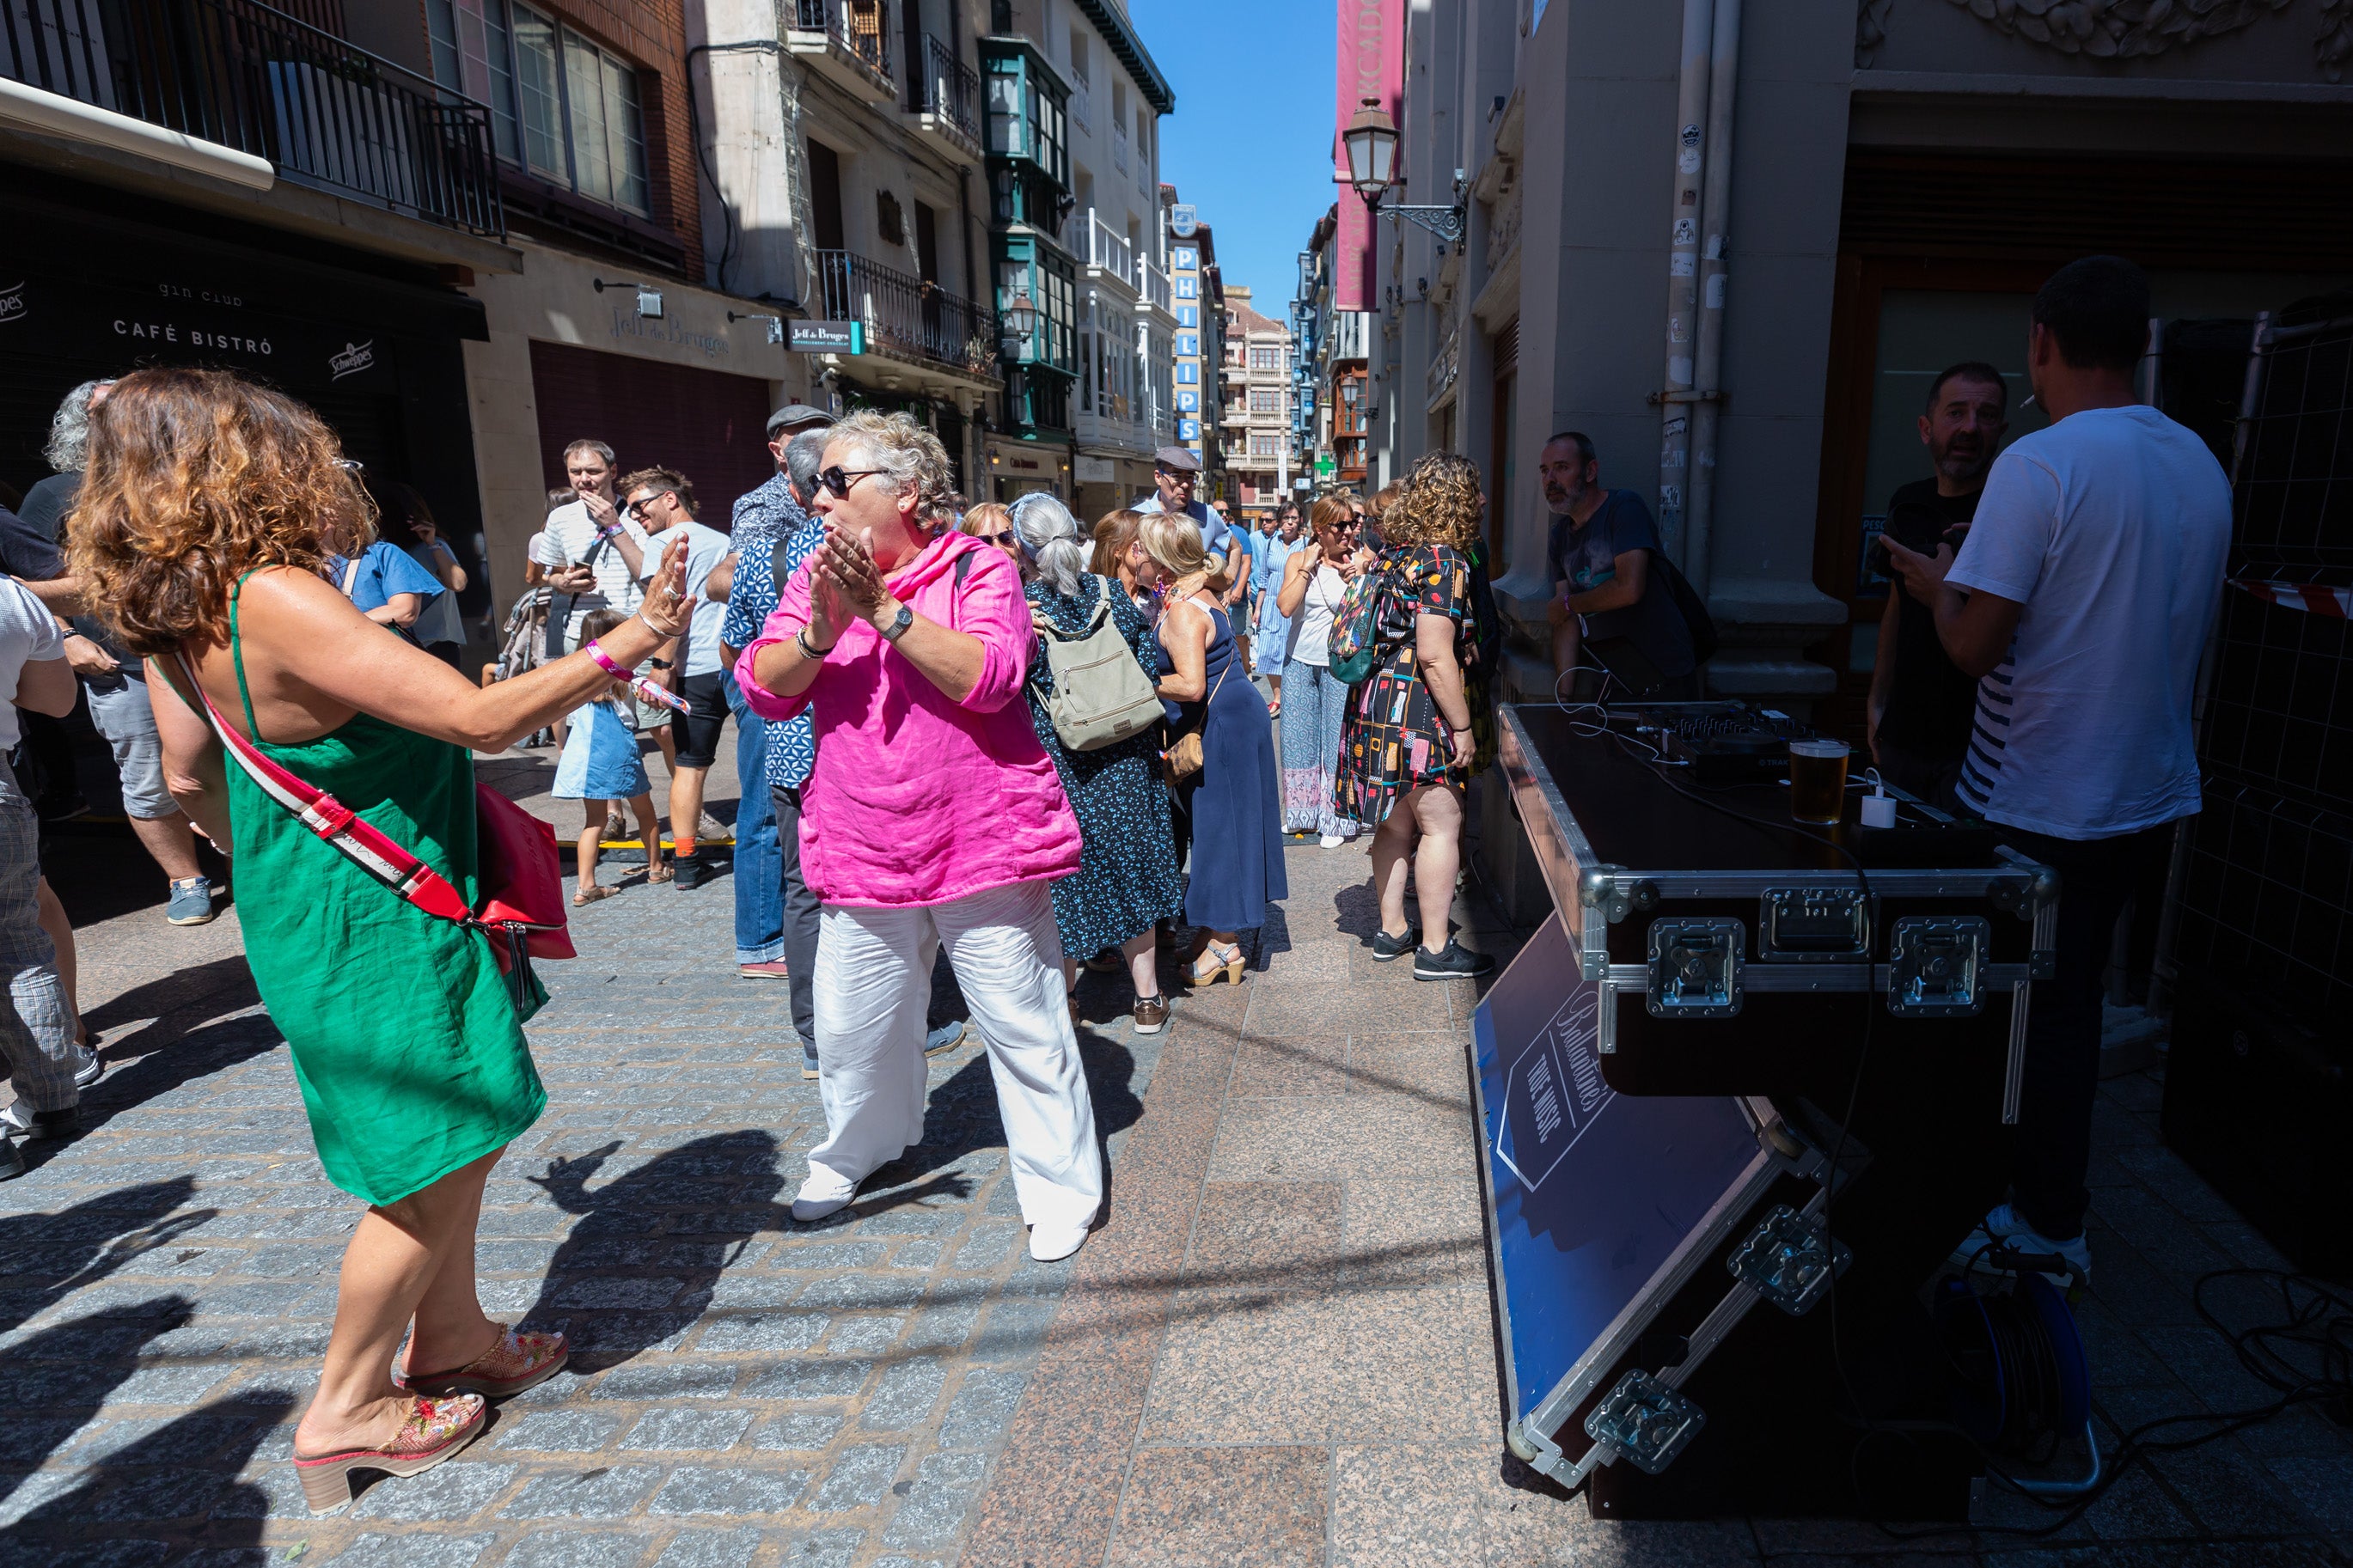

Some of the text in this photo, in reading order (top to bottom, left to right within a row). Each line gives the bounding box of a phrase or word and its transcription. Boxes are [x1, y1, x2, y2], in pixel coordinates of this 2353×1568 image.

[113, 319, 272, 356] CAFÉ BISTRÓ
[610, 307, 648, 338] Jeff
[667, 313, 729, 358] Bruges
[792, 328, 810, 340] Jeff
[818, 327, 849, 342] Bruges
[1177, 249, 1195, 439] PHILIPS
[332, 348, 372, 375] Schweppes
[1526, 1052, 1562, 1144] TRUE MUSIC
